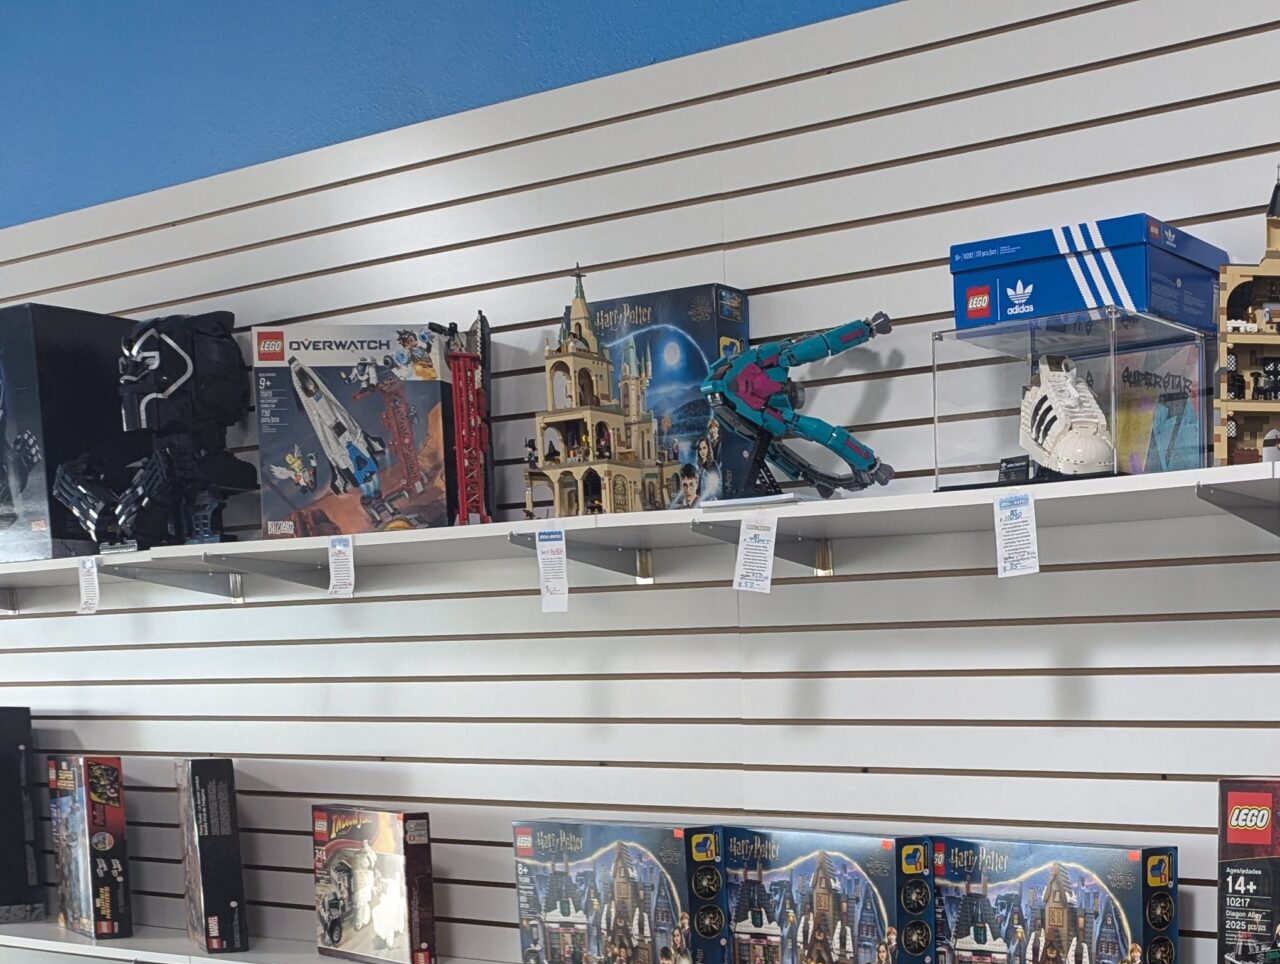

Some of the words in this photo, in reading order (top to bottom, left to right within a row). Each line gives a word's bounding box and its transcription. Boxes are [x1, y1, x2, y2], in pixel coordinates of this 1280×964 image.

[968, 295, 989, 309] LEGO
[1007, 304, 1034, 315] adidas
[594, 308, 622, 335] Harry
[623, 303, 652, 326] Potter
[260, 341, 282, 351] LEGO
[289, 340, 391, 351] OVERWATCH
[259, 378, 271, 390] 9+
[1122, 366, 1193, 393] SUPERSTAR
[267, 521, 294, 534] BLIZZARD
[1229, 806, 1272, 830] LEGO
[728, 837, 754, 862] Harry
[754, 835, 780, 861] Potter
[934, 852, 944, 864] GO
[950, 848, 978, 874] Harry
[978, 846, 1009, 873] Potter
[517, 864, 529, 875] 8+
[1226, 867, 1262, 875] Ages/edades
[1226, 876, 1257, 894] 14+
[1226, 898, 1250, 907] 10217
[1226, 910, 1246, 919] Diagon
[208, 916, 219, 937] MARVEL
[1226, 921, 1246, 930] 2025
